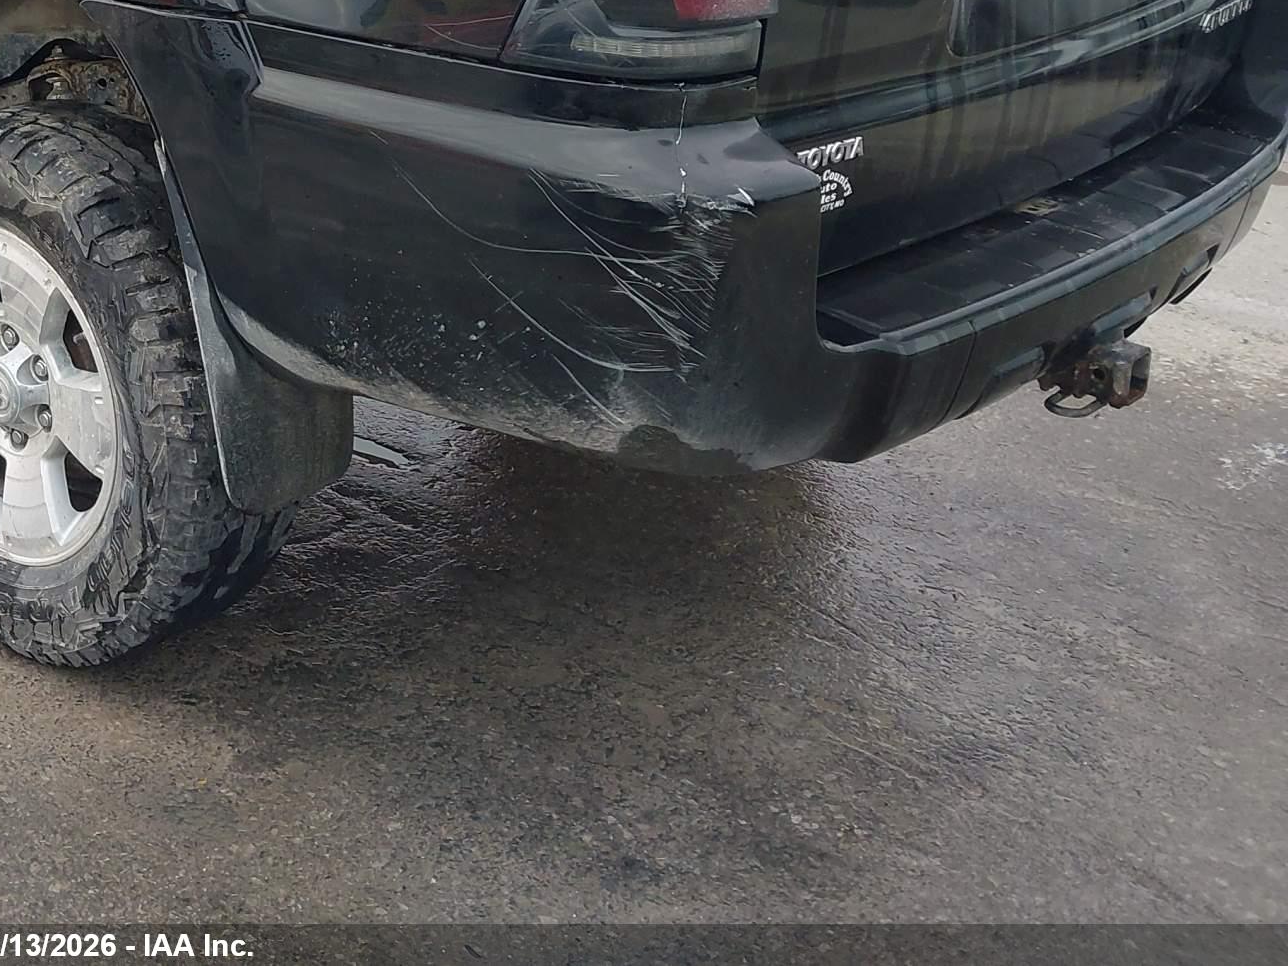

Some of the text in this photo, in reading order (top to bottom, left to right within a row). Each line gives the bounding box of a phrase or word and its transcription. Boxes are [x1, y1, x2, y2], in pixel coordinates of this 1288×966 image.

[796, 136, 864, 170] TOYOTA
[820, 182, 838, 194] uto
[822, 168, 853, 197] Country
